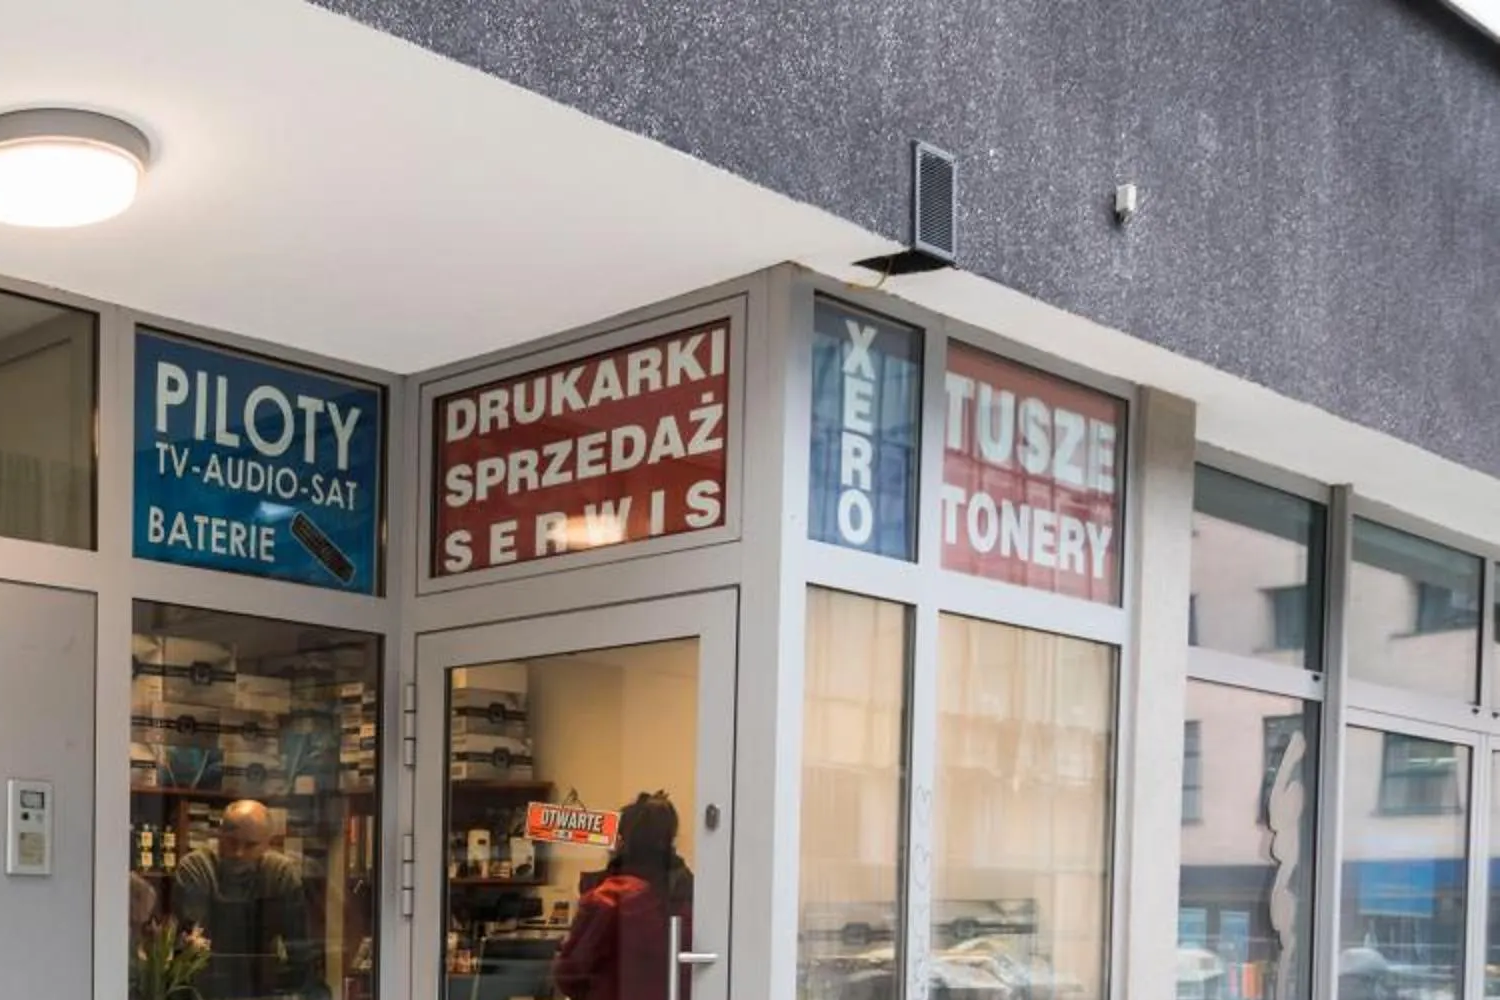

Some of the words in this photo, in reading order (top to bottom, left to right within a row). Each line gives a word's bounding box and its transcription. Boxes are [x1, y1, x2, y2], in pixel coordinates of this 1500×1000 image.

[156, 361, 361, 471] PILOTY
[446, 329, 726, 442] DRUKARKI
[838, 320, 877, 545] XERO
[944, 371, 1116, 494] TUSZE
[445, 392, 723, 507] SPRZEDAŻ
[148, 506, 276, 563] BATERIE
[444, 480, 721, 572] SERWIS
[941, 483, 1112, 580] TONERY
[540, 808, 604, 832] OTWARTE
